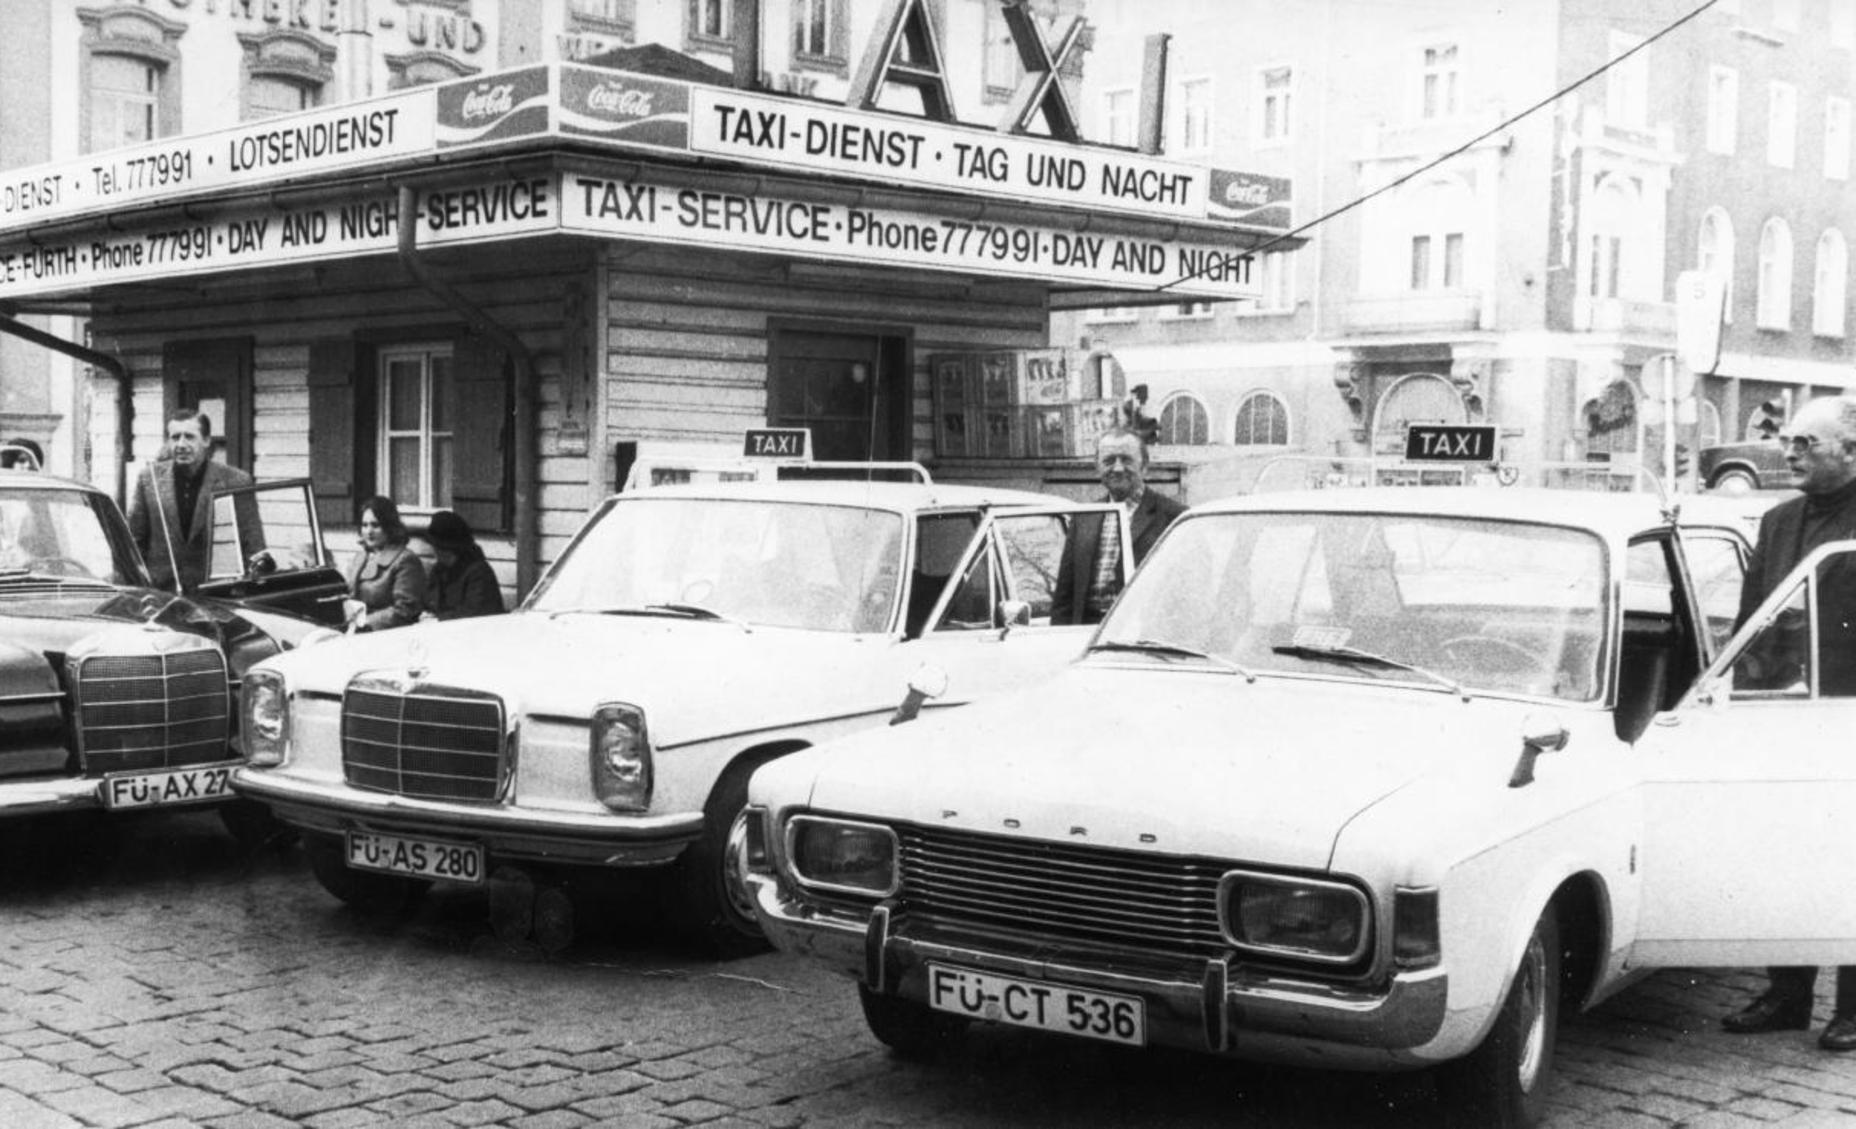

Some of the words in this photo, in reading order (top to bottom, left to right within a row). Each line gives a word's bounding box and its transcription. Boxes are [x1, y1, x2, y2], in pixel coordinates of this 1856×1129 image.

[92, 163, 122, 196] Tel.
[126, 148, 192, 190] 777991
[230, 108, 399, 172] LOTSENDIENST
[714, 104, 925, 169] TAXI-DIENST
[953, 142, 1008, 182] TAG
[1026, 153, 1086, 191] UND
[1101, 163, 1193, 205] NACHT
[91, 240, 144, 271] Phone
[228, 217, 269, 254] DAY
[281, 210, 327, 248] AND
[575, 178, 831, 242] TAXI-SERVICE
[847, 210, 938, 252] Phone
[1052, 234, 1104, 269] DAY
[1112, 240, 1166, 275] AND
[1178, 248, 1255, 284] NIGHT
[753, 434, 798, 454] TAXI
[1418, 431, 1482, 456] TAXI
[942, 809, 1157, 844] FORD
[434, 845, 477, 877] 280
[1066, 993, 1135, 1039] 536
